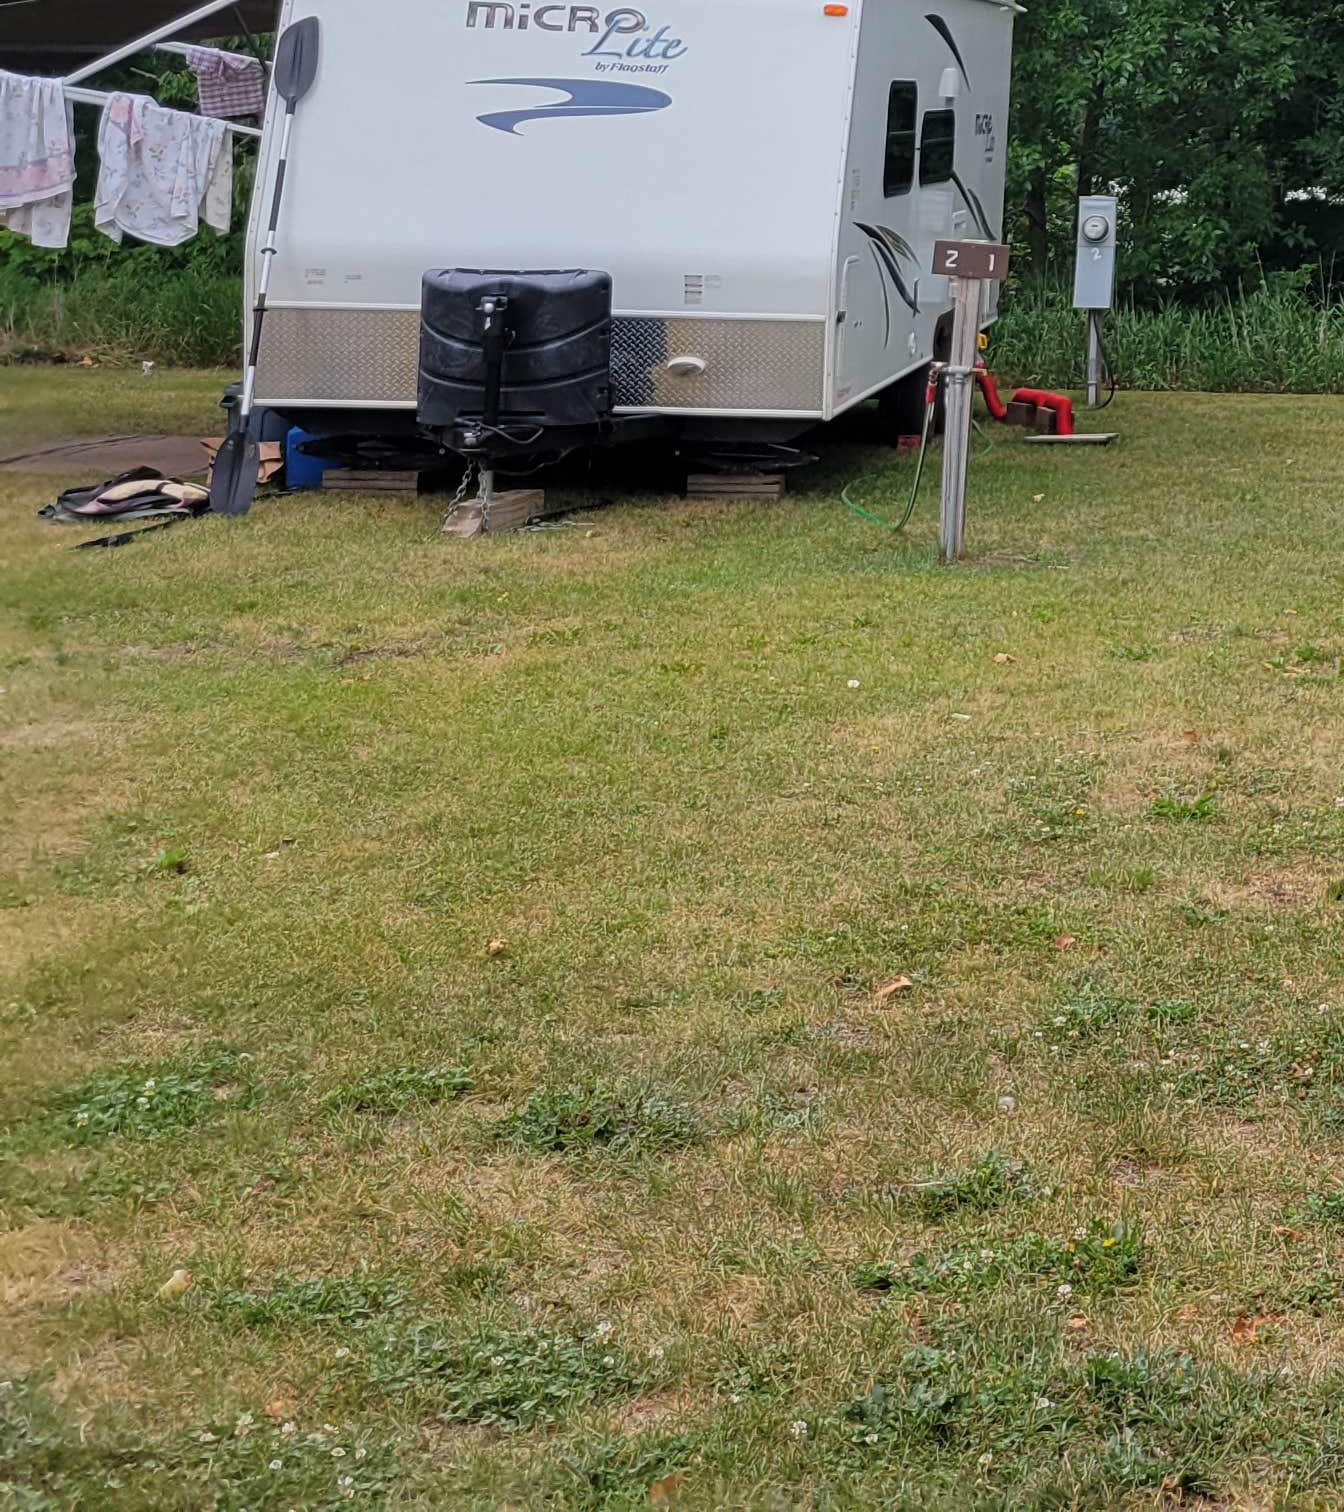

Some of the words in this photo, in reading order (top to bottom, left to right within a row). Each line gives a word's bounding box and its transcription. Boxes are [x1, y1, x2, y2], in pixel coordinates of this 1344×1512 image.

[580, 17, 689, 60] Lite
[610, 62, 669, 75] Flagstaff
[945, 249, 959, 268] 2
[988, 253, 996, 272] 1
[1090, 247, 1103, 261] 2
